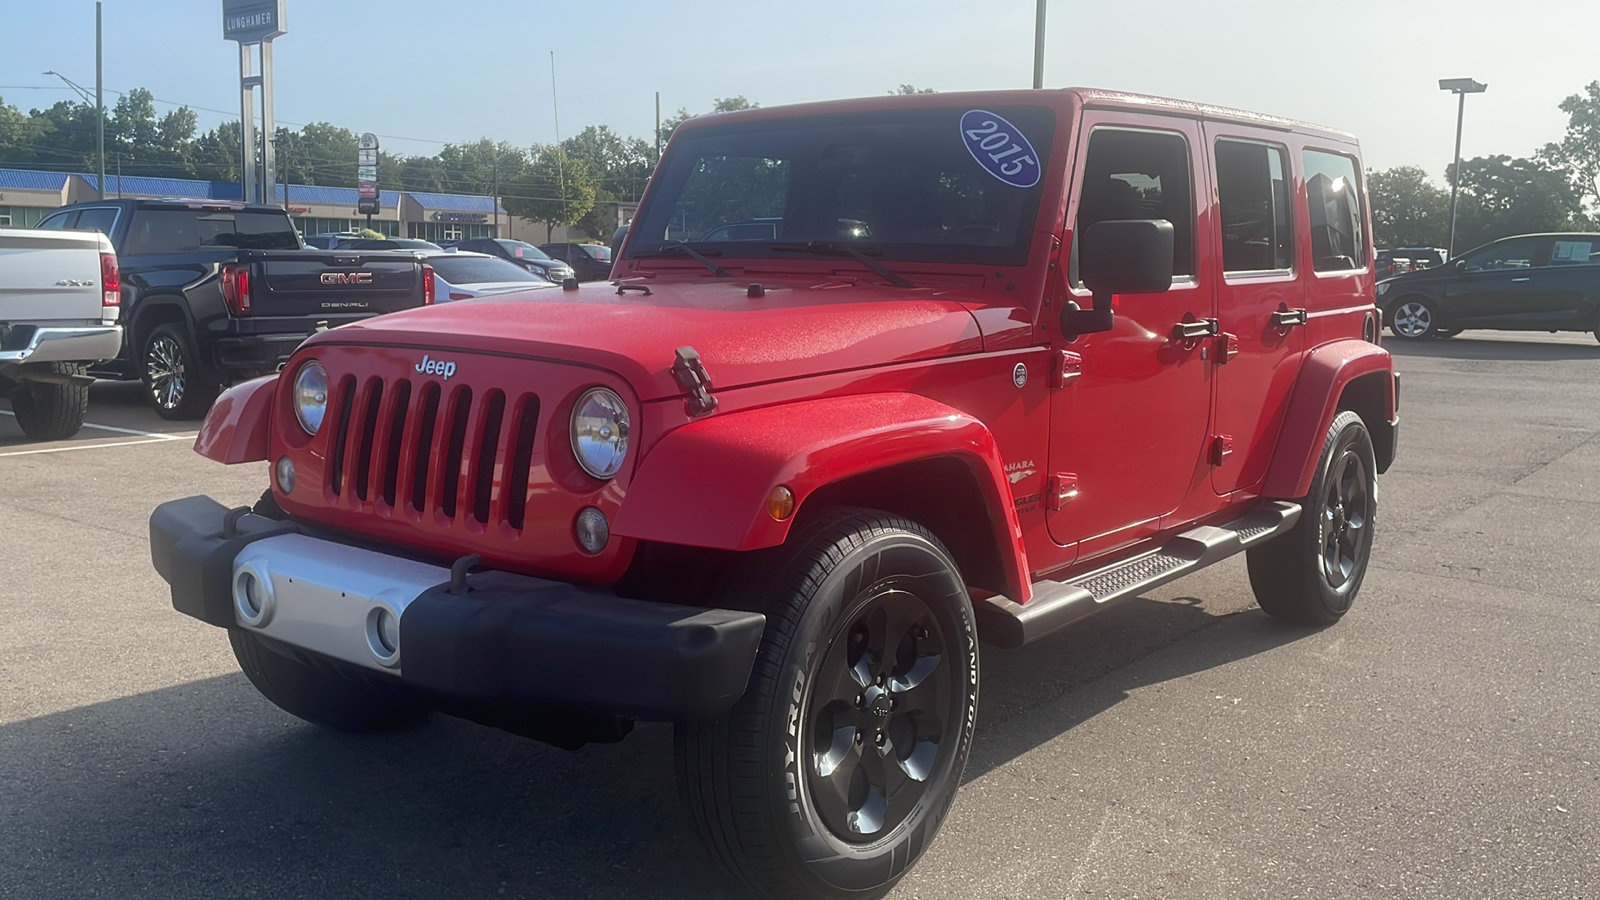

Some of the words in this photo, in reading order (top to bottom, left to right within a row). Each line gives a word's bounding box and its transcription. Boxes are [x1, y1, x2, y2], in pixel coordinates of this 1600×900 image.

[227, 12, 272, 30] LUNGHAMER
[965, 120, 1035, 176] 2015
[320, 272, 373, 285] GMC
[415, 354, 457, 381] Jeep
[1004, 459, 1035, 472] AHARA
